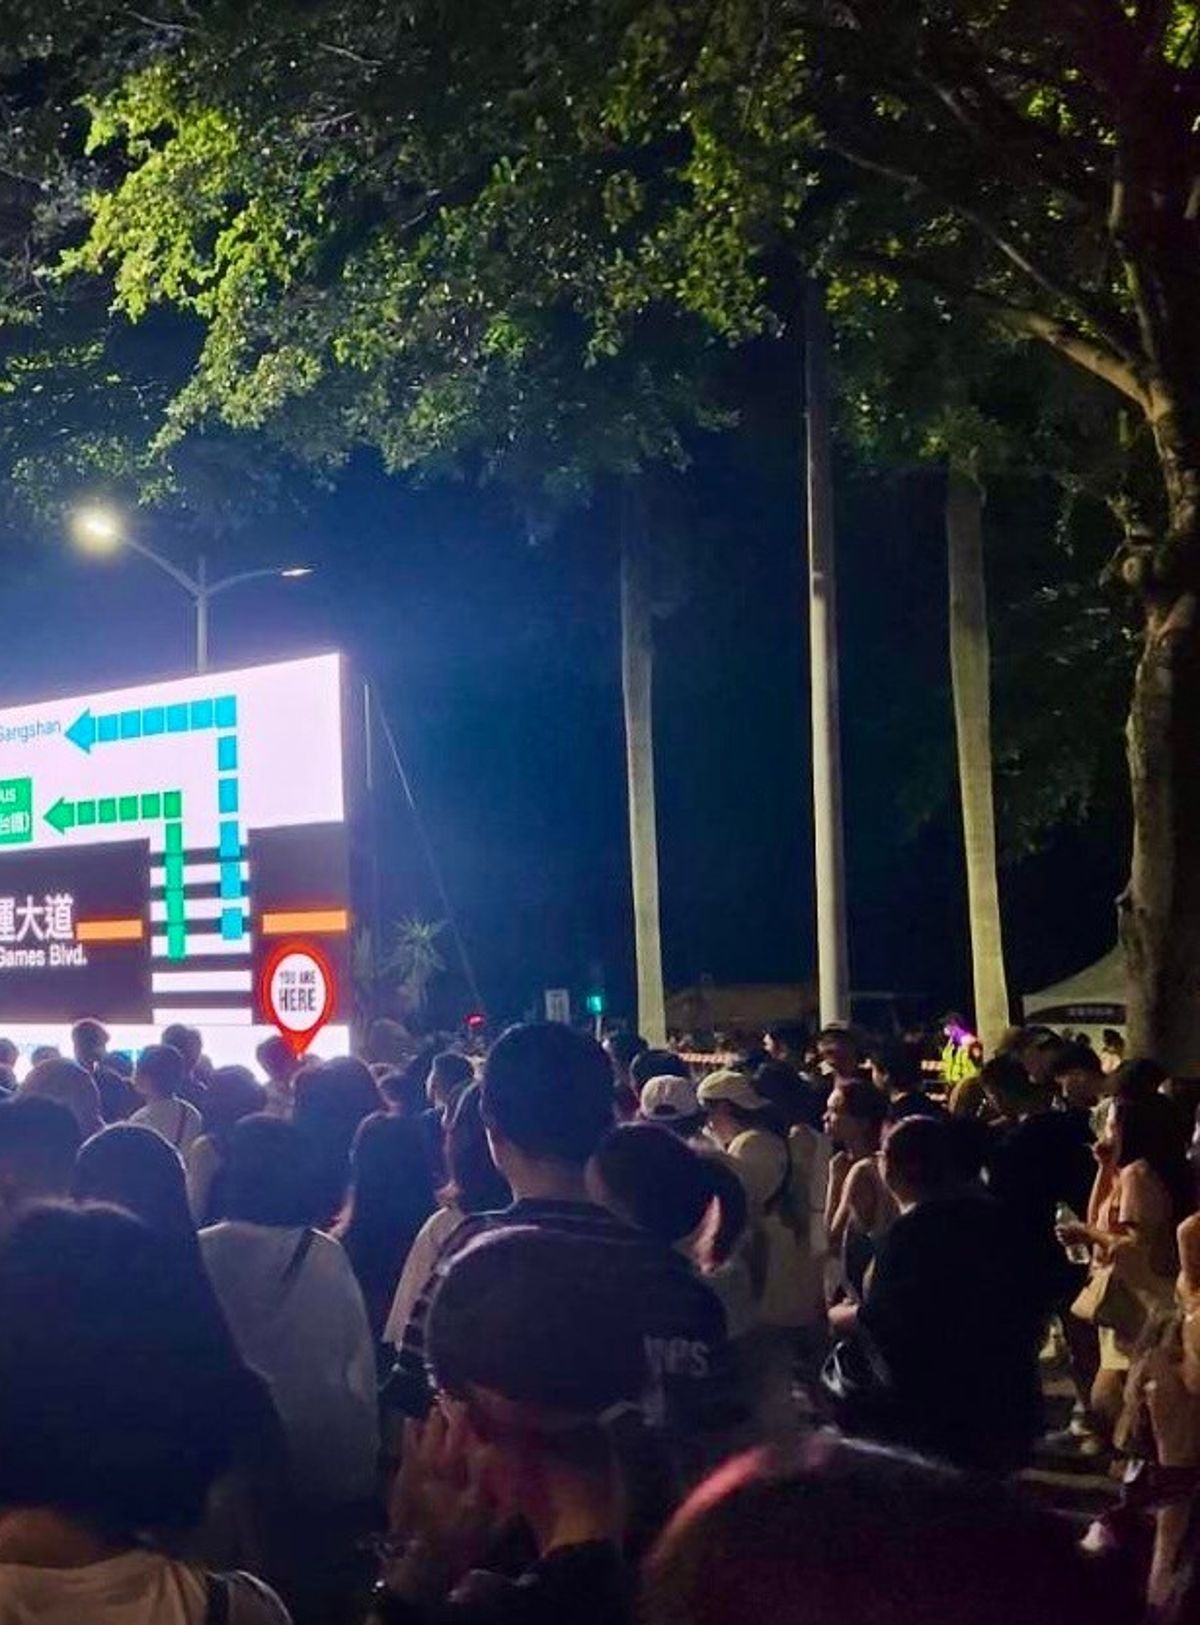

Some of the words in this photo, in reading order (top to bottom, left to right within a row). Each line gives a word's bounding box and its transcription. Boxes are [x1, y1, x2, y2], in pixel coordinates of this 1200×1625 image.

[49, 943, 88, 967] Blvd.
[279, 970, 297, 985] YOU
[299, 969, 316, 984] ARE
[278, 987, 317, 1012] HERE
